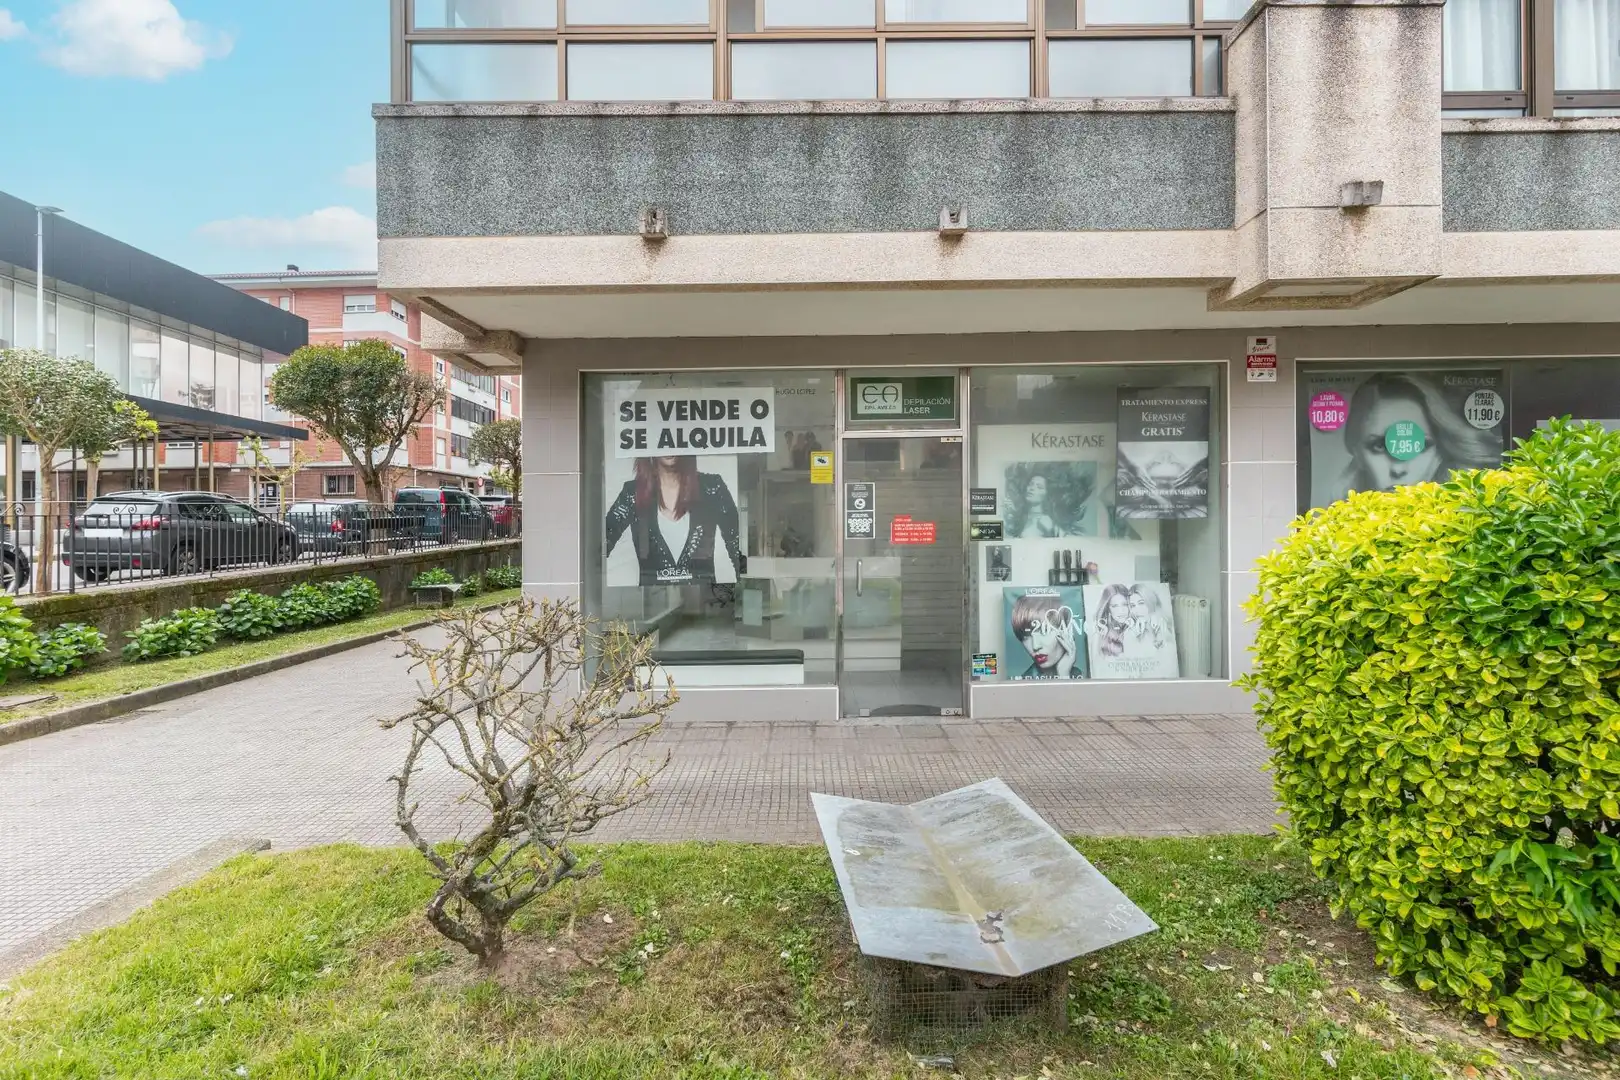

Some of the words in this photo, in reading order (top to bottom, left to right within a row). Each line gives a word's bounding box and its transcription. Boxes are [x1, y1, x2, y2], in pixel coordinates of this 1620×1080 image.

[903, 397, 951, 406] DEPILACIÓN
[620, 401, 647, 422] SE
[657, 400, 740, 421] VENDE
[750, 398, 770, 420] O
[1312, 410, 1337, 424] 10,80
[1338, 411, 1345, 422] €
[1467, 408, 1493, 421] 11,90
[1495, 410, 1501, 421] €
[620, 428, 647, 449] SE
[657, 426, 767, 449] ALQUILA
[1031, 432, 1105, 448] KÉRASTASE
[1390, 440, 1412, 454] 7,95
[1414, 441, 1420, 452] €
